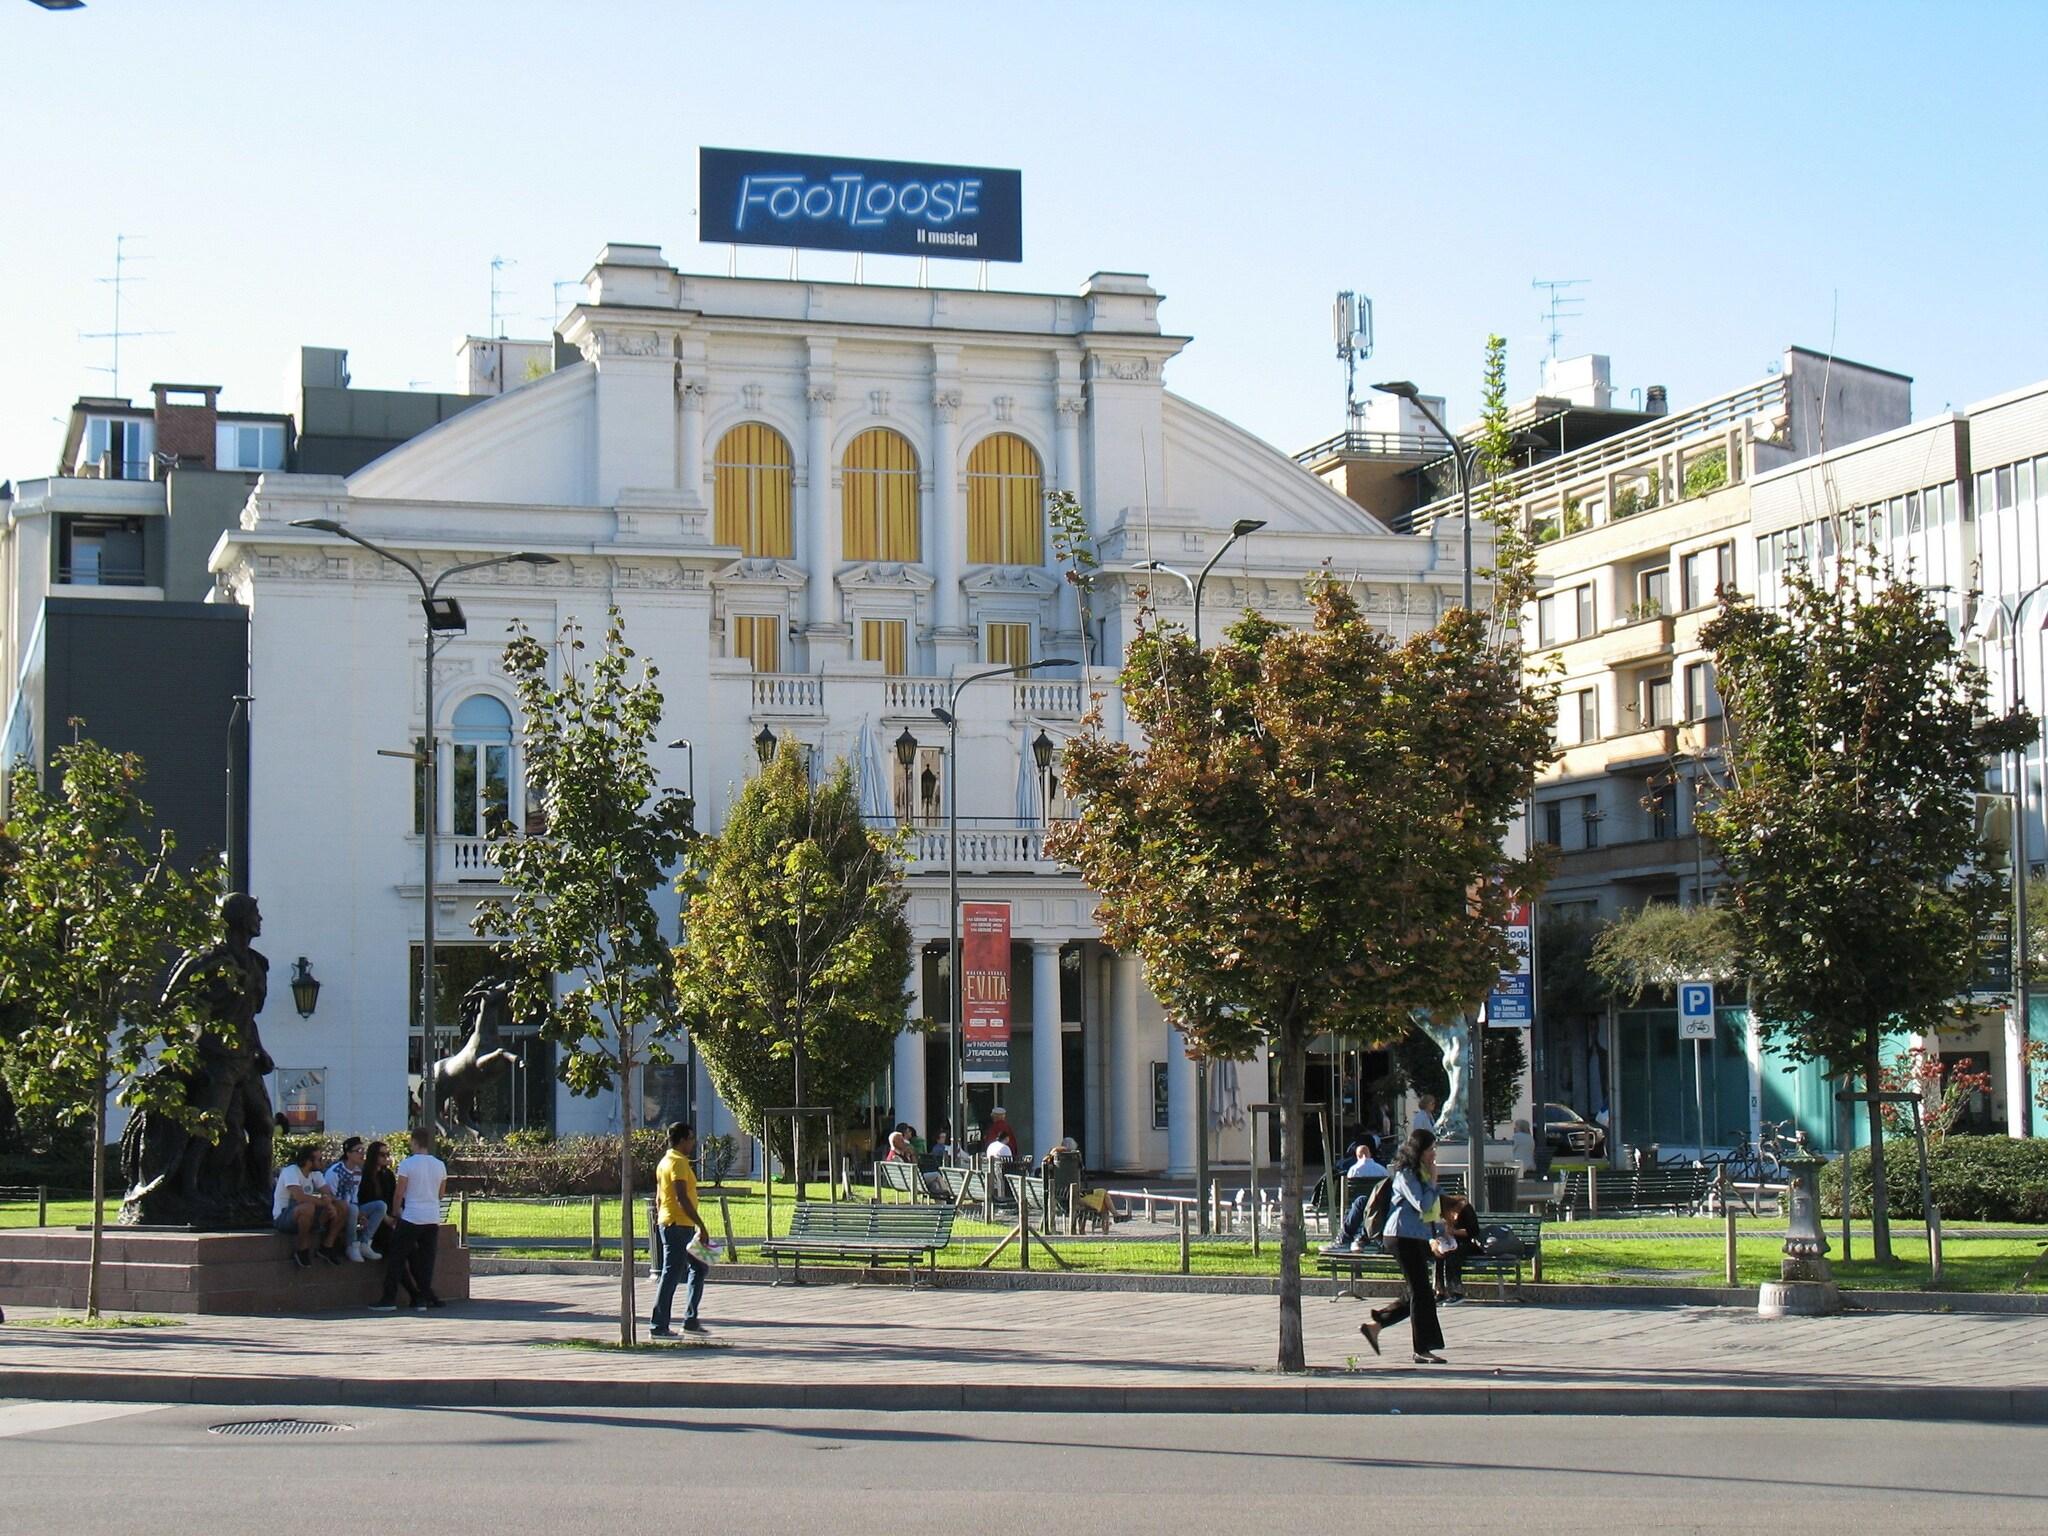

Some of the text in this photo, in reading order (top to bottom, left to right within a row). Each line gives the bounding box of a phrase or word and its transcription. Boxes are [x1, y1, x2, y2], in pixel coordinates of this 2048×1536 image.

[735, 174, 982, 231] FOOTLOOSE
[916, 228, 978, 246] Il musical
[967, 975, 1008, 1001] EVITA
[1689, 989, 1706, 1012] P
